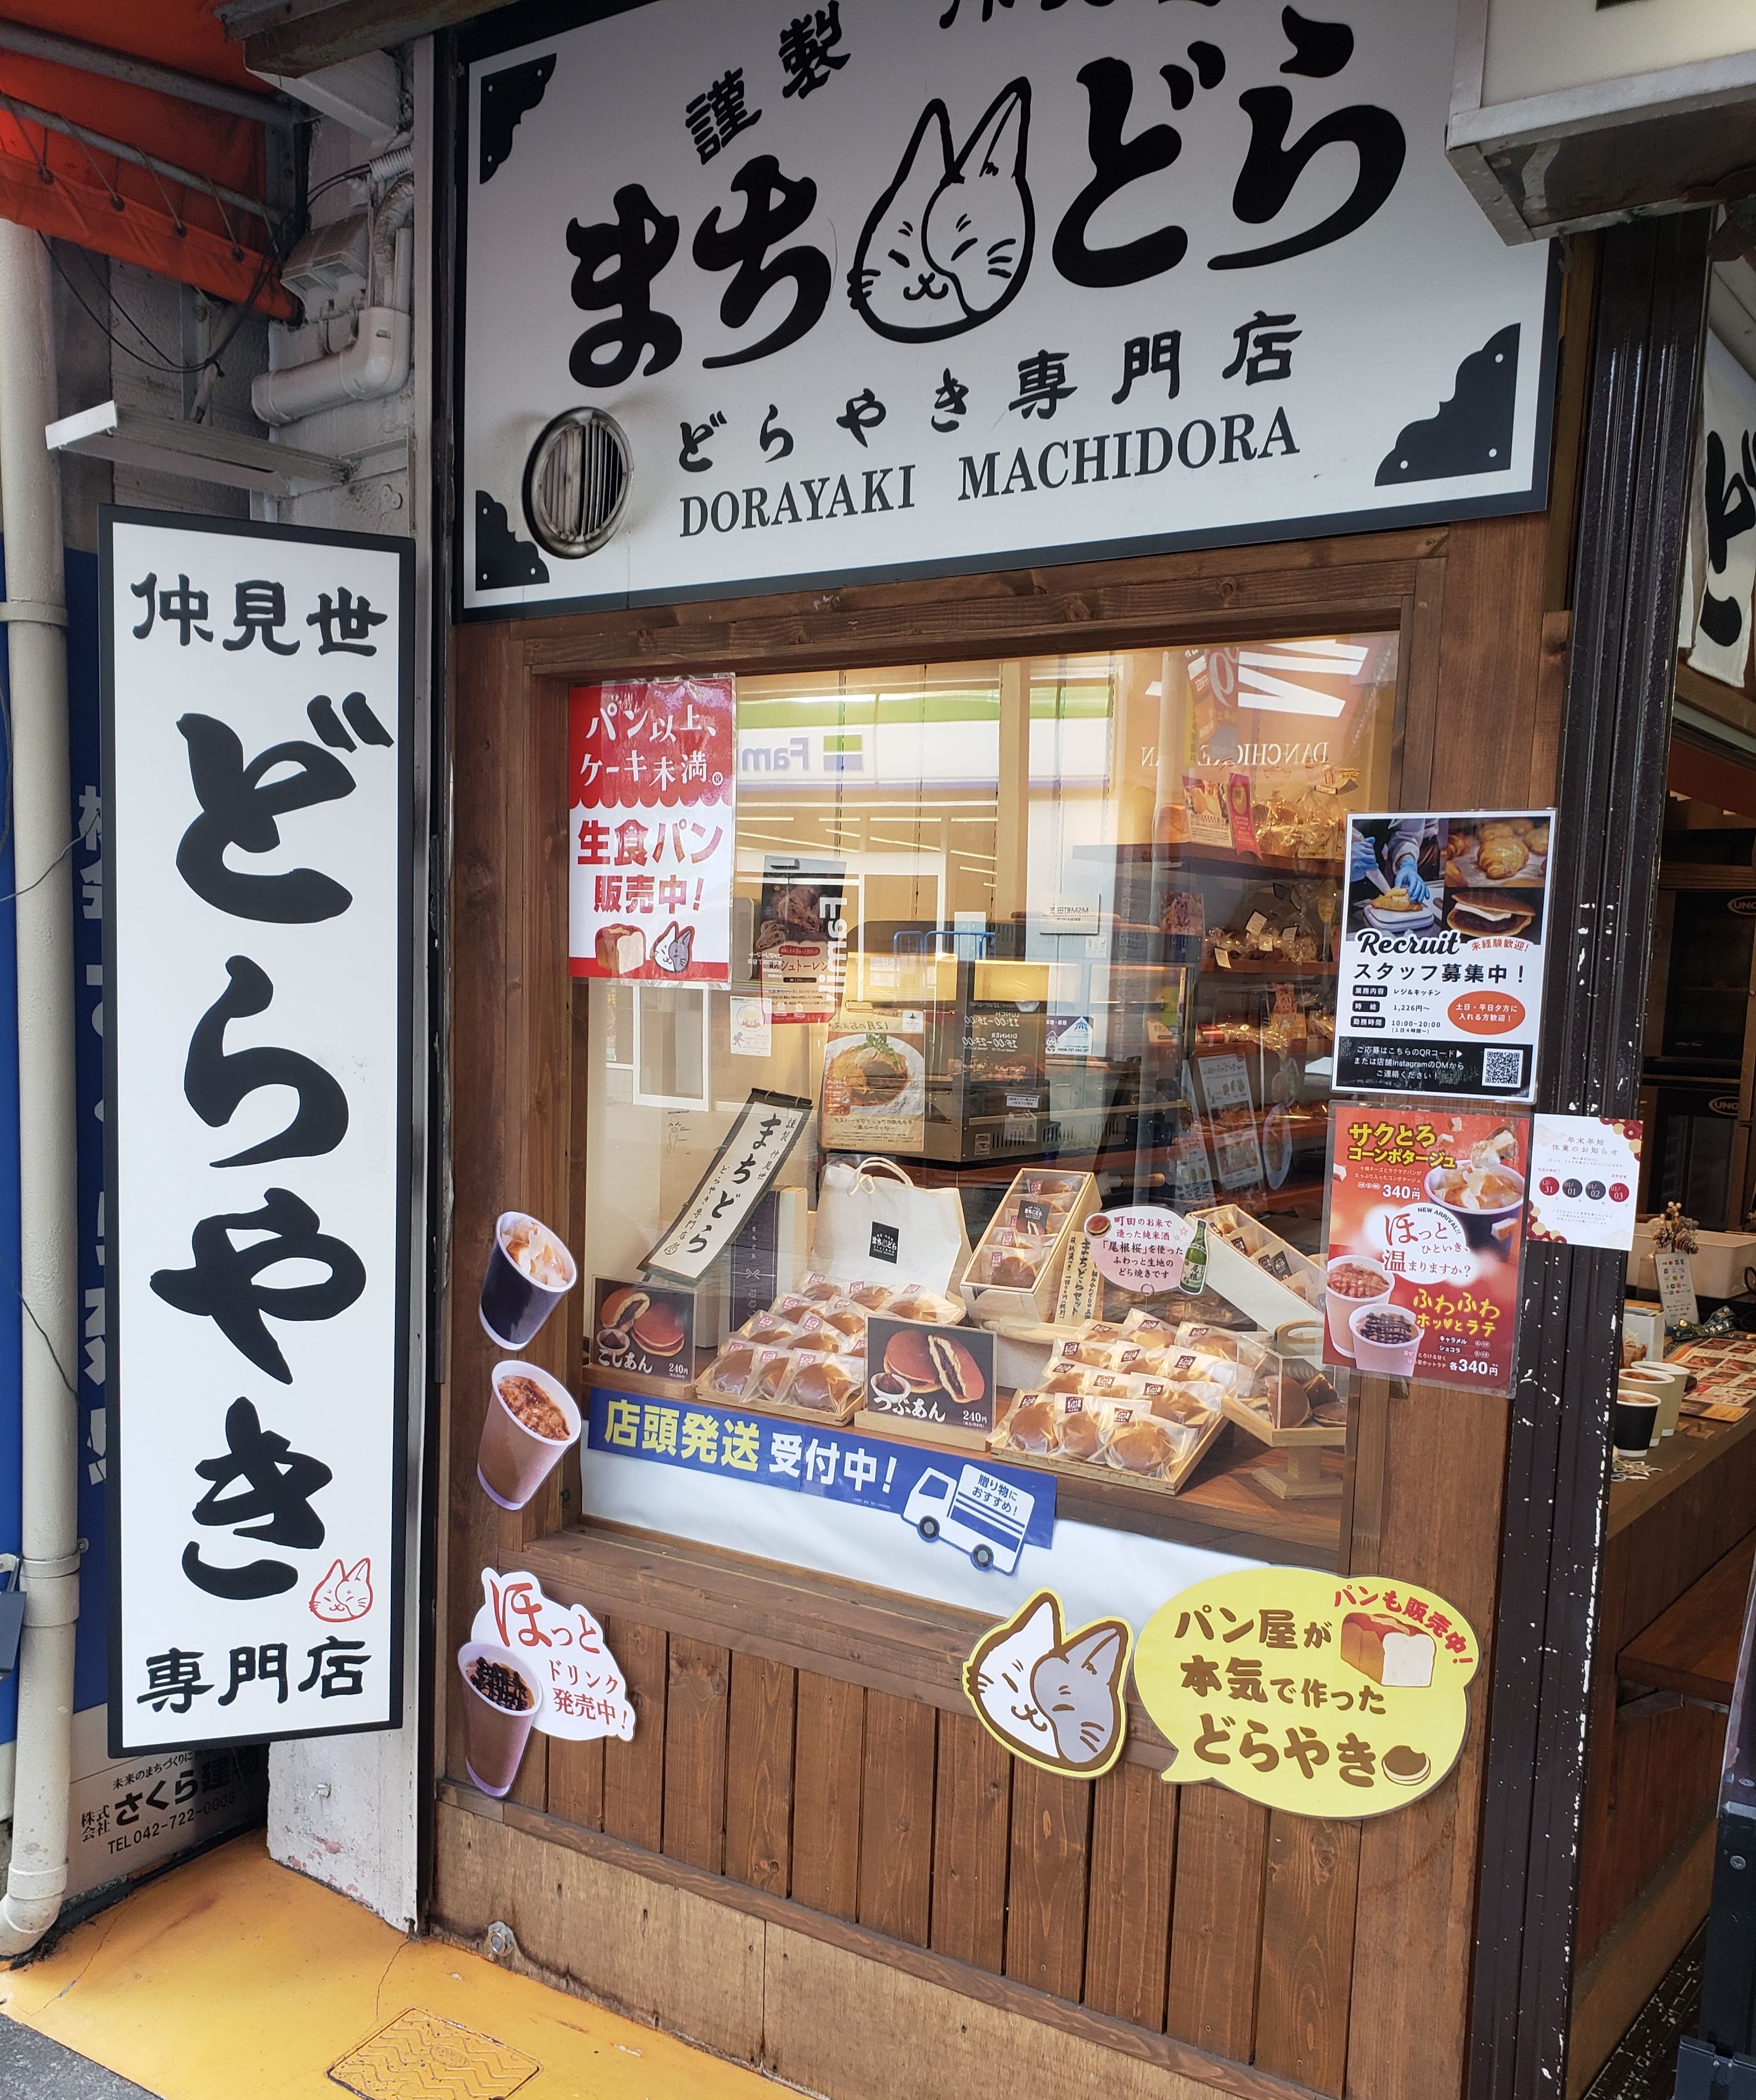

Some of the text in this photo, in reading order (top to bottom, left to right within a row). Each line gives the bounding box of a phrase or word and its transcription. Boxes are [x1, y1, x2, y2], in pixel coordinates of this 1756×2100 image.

[686, 0, 851, 165] 謹製
[678, 311, 1304, 473] どらやき専門店
[679, 406, 1300, 538] DORAYAKI MACHIDORA
[131, 572, 388, 657] 仲見世
[586, 702, 717, 741] パン以上、
[577, 819, 724, 866] 生食パン
[593, 874, 705, 914] 販売中!
[1357, 930, 1460, 955] Recruit
[1354, 961, 1524, 984] スタッフ募集中!
[1393, 988, 1441, 996] レジ&キッチン
[1352, 1018, 1383, 1026] 勤務時間
[1455, 1003, 1518, 1013] 土日・平日夕方に
[150, 691, 395, 1601] どらやき
[1348, 1122, 1436, 1148] サクとろ
[1348, 1147, 1456, 1168] コーンポタージュ
[686, 1113, 781, 1253] まちどら
[1382, 1184, 1420, 1200] 340円
[679, 1165, 730, 1240] どらやき専門店
[1113, 1215, 1173, 1227] 町田のお米で
[1116, 1229, 1170, 1241] 造った純米酒
[1384, 1213, 1448, 1246] ほっと
[1434, 1209, 1461, 1235] ARRIVAL!!
[1103, 1241, 1184, 1255] 「尾根桜」を使った
[1113, 1256, 1174, 1267] ふわっと生地の
[1072, 1238, 1091, 1316] まちどらセット
[1118, 1269, 1170, 1279] どら焼きです
[1413, 1288, 1500, 1319] ふわふわ
[1439, 1345, 1461, 1353] ショコラ
[1440, 1335, 1467, 1344] キャラメル
[598, 1348, 653, 1374] こしあん
[668, 1362, 689, 1375] 240円
[1449, 1359, 1498, 1376] 各340円
[873, 1395, 947, 1422] つぶあん
[962, 1410, 987, 1424] 240円
[604, 1399, 899, 1493] 店頭発送 受付中!
[971, 1485, 1018, 1517] おすすめ!
[977, 1474, 1019, 1503] 贈り物に
[490, 1579, 600, 1654] ほっと
[1174, 1604, 1333, 1649] パン屋が
[1334, 1584, 1474, 1665] パンも販売中!
[137, 1634, 372, 1714] 専門店
[549, 1659, 619, 1695] ドリンク
[1180, 1655, 1387, 1716] 本気で作った
[552, 1687, 628, 1730] 発売中!
[1193, 1713, 1377, 1788] どらやき
